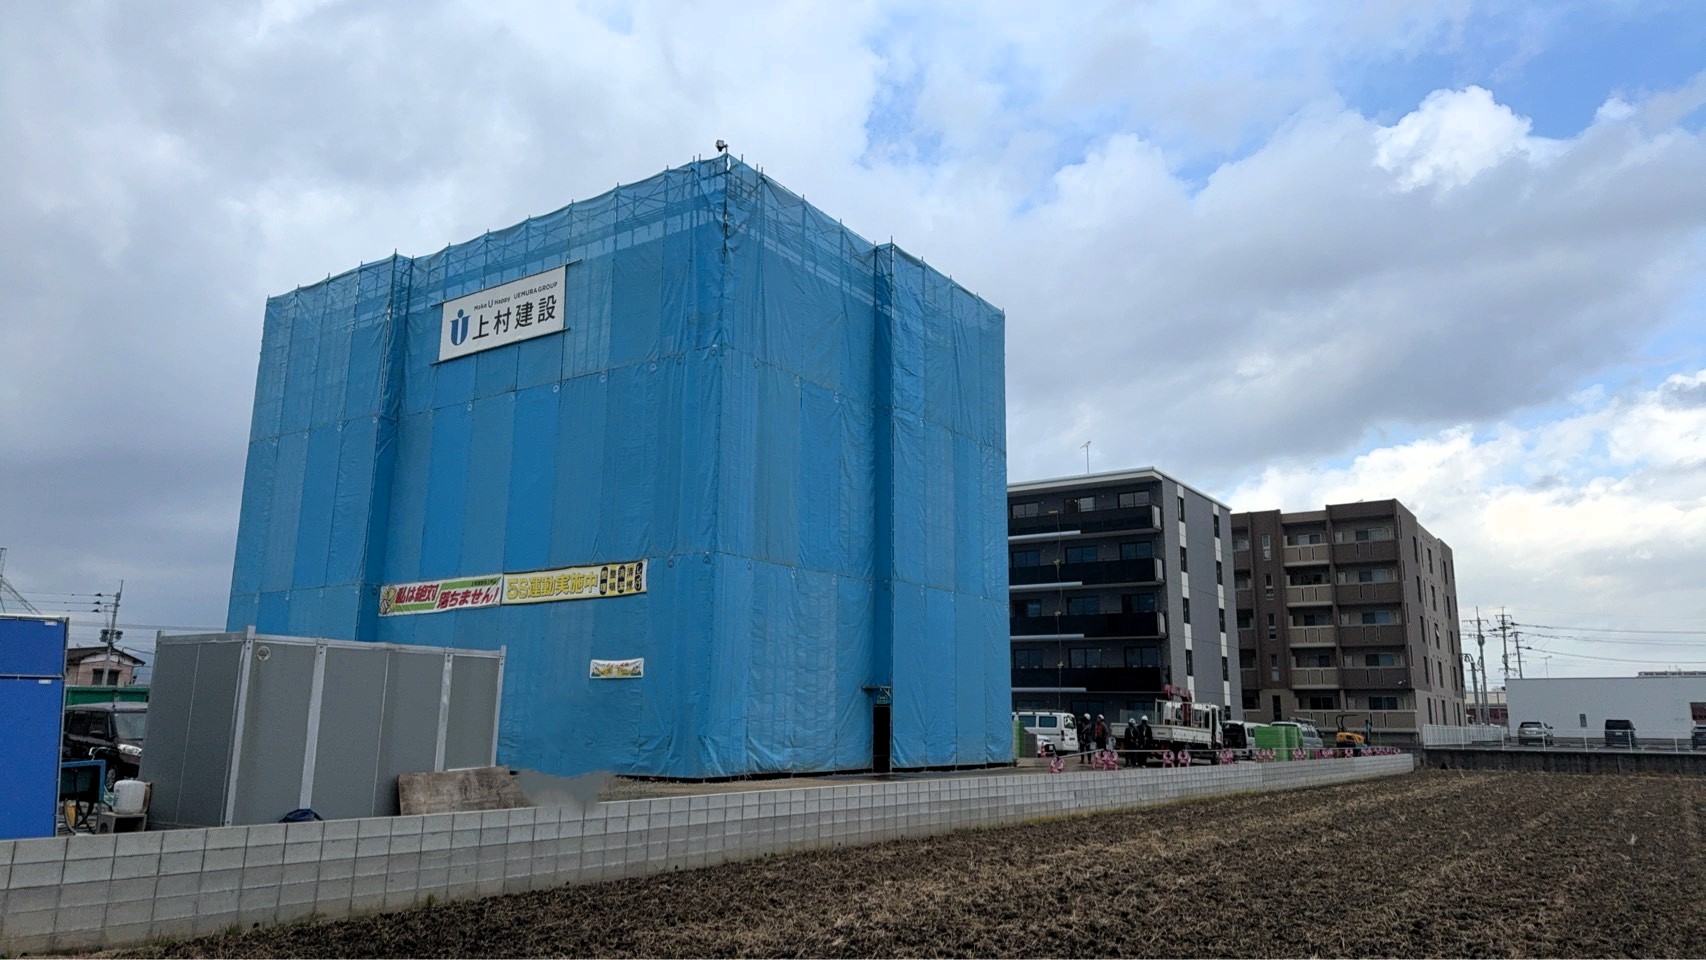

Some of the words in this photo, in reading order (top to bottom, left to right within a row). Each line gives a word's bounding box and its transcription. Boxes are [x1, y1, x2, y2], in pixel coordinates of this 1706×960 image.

[514, 287, 537, 299] UEMURA
[538, 281, 558, 292] GROUP
[474, 303, 487, 311] Make
[488, 300, 493, 308] U
[472, 294, 557, 340] 上村建設
[395, 584, 439, 604] 私は絶対
[506, 572, 598, 600] 5S運動実施中
